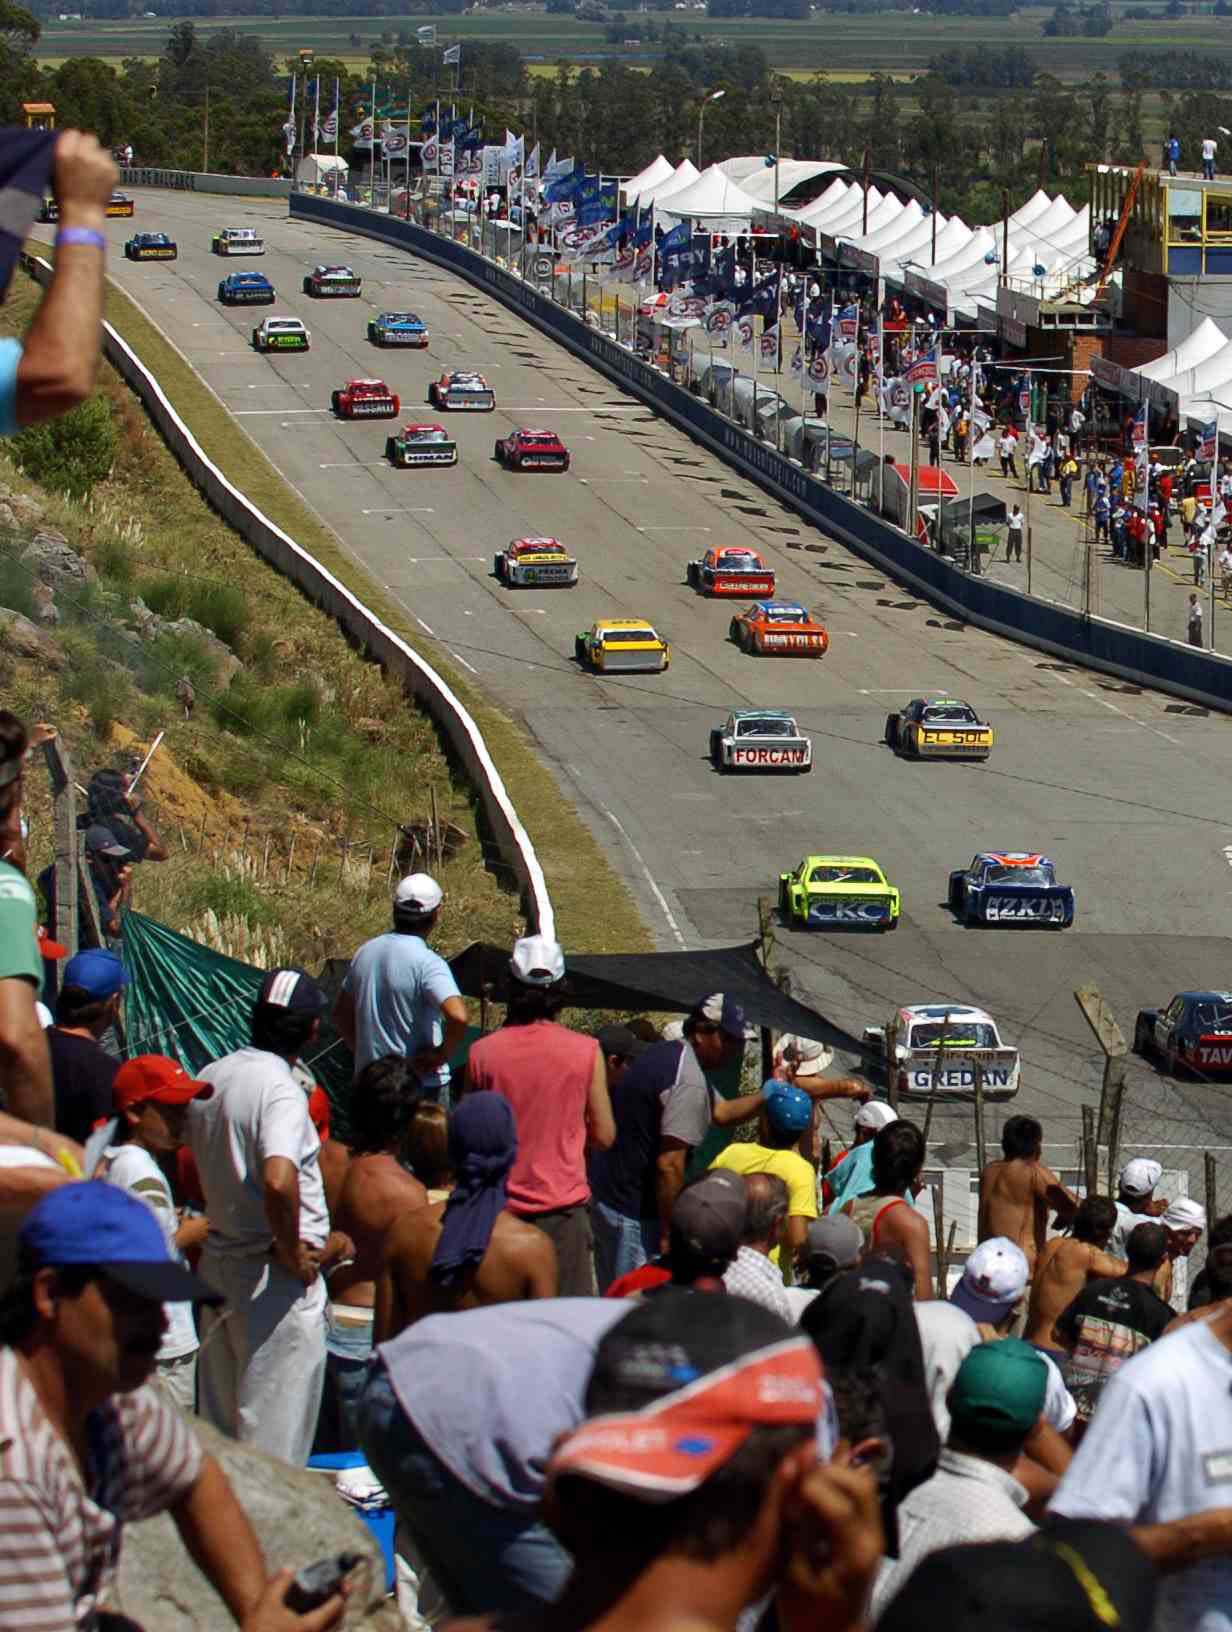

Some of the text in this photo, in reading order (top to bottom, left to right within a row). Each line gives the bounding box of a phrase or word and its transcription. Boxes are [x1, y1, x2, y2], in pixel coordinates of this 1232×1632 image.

[923, 730, 989, 744] EL SOL
[735, 747, 806, 764] FORCAM
[914, 1070, 1009, 1087] GREDAN
